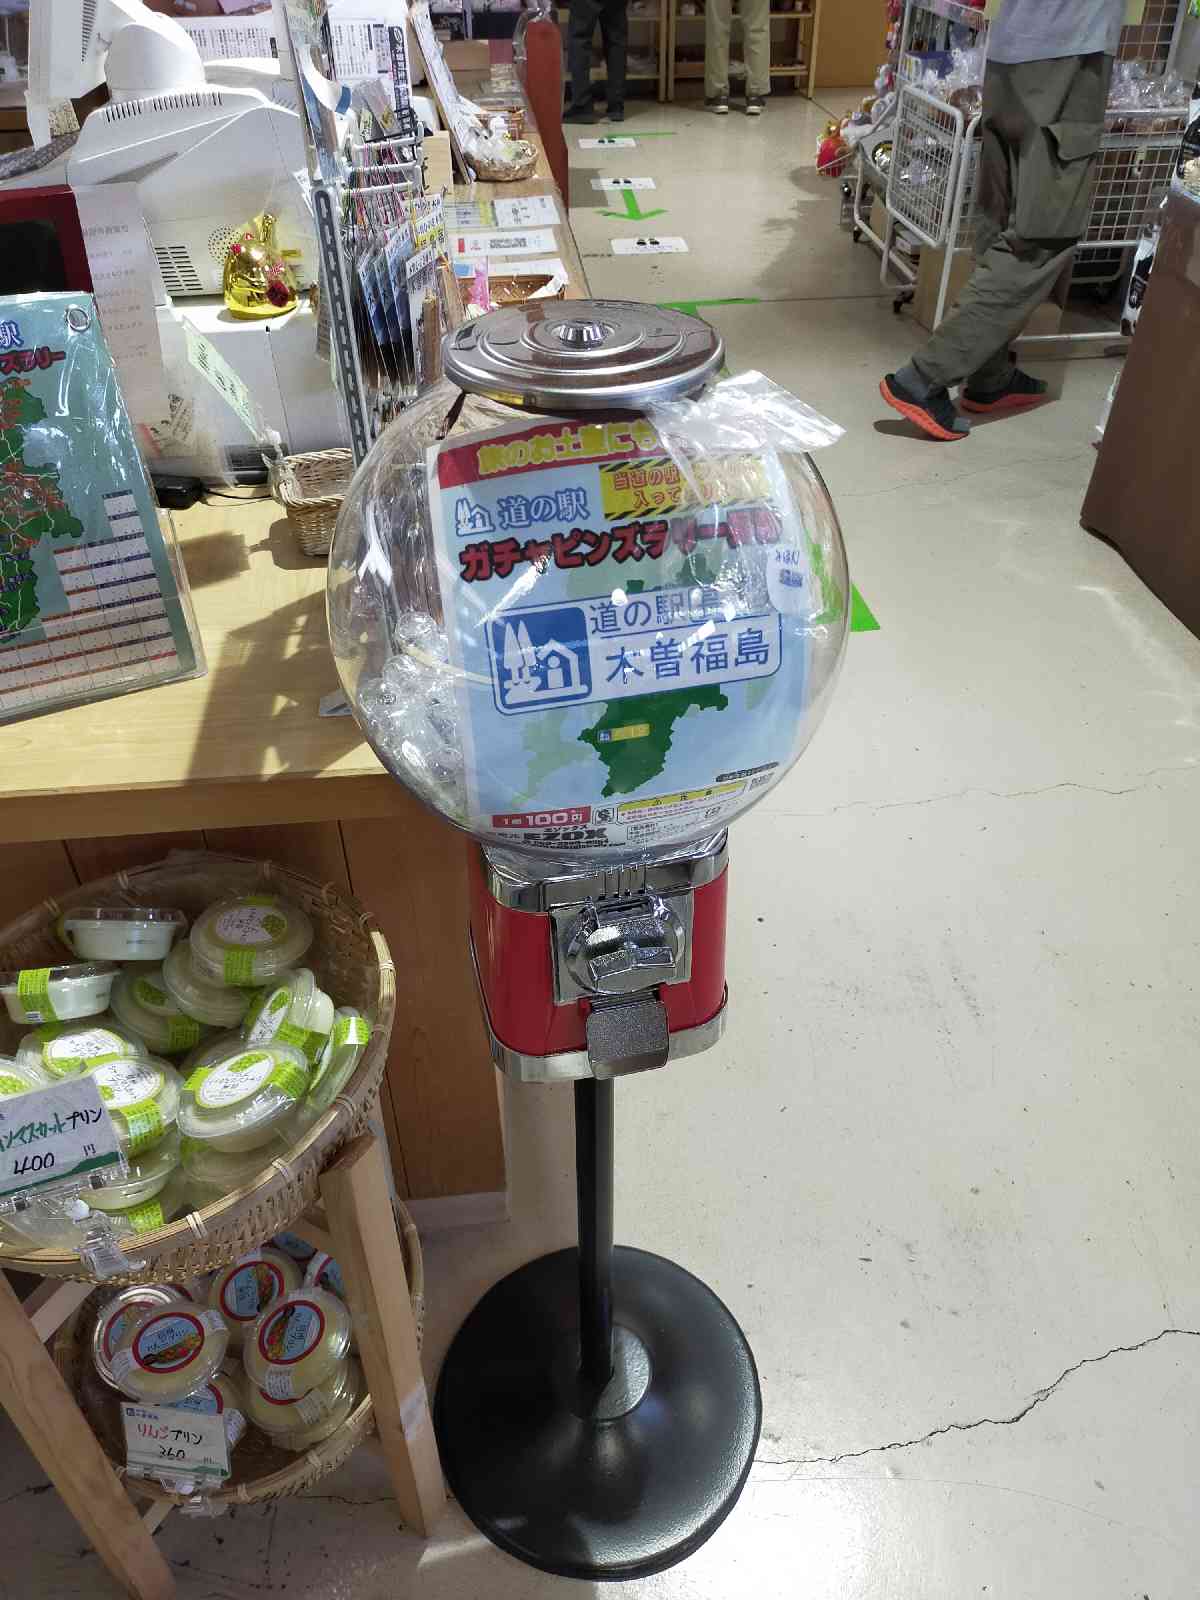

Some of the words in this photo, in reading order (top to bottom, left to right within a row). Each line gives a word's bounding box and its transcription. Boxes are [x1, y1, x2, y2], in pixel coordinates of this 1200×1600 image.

[500, 488, 590, 531] 道の駅
[605, 627, 770, 683] 木曽福島
[14, 1152, 55, 1175] 400
